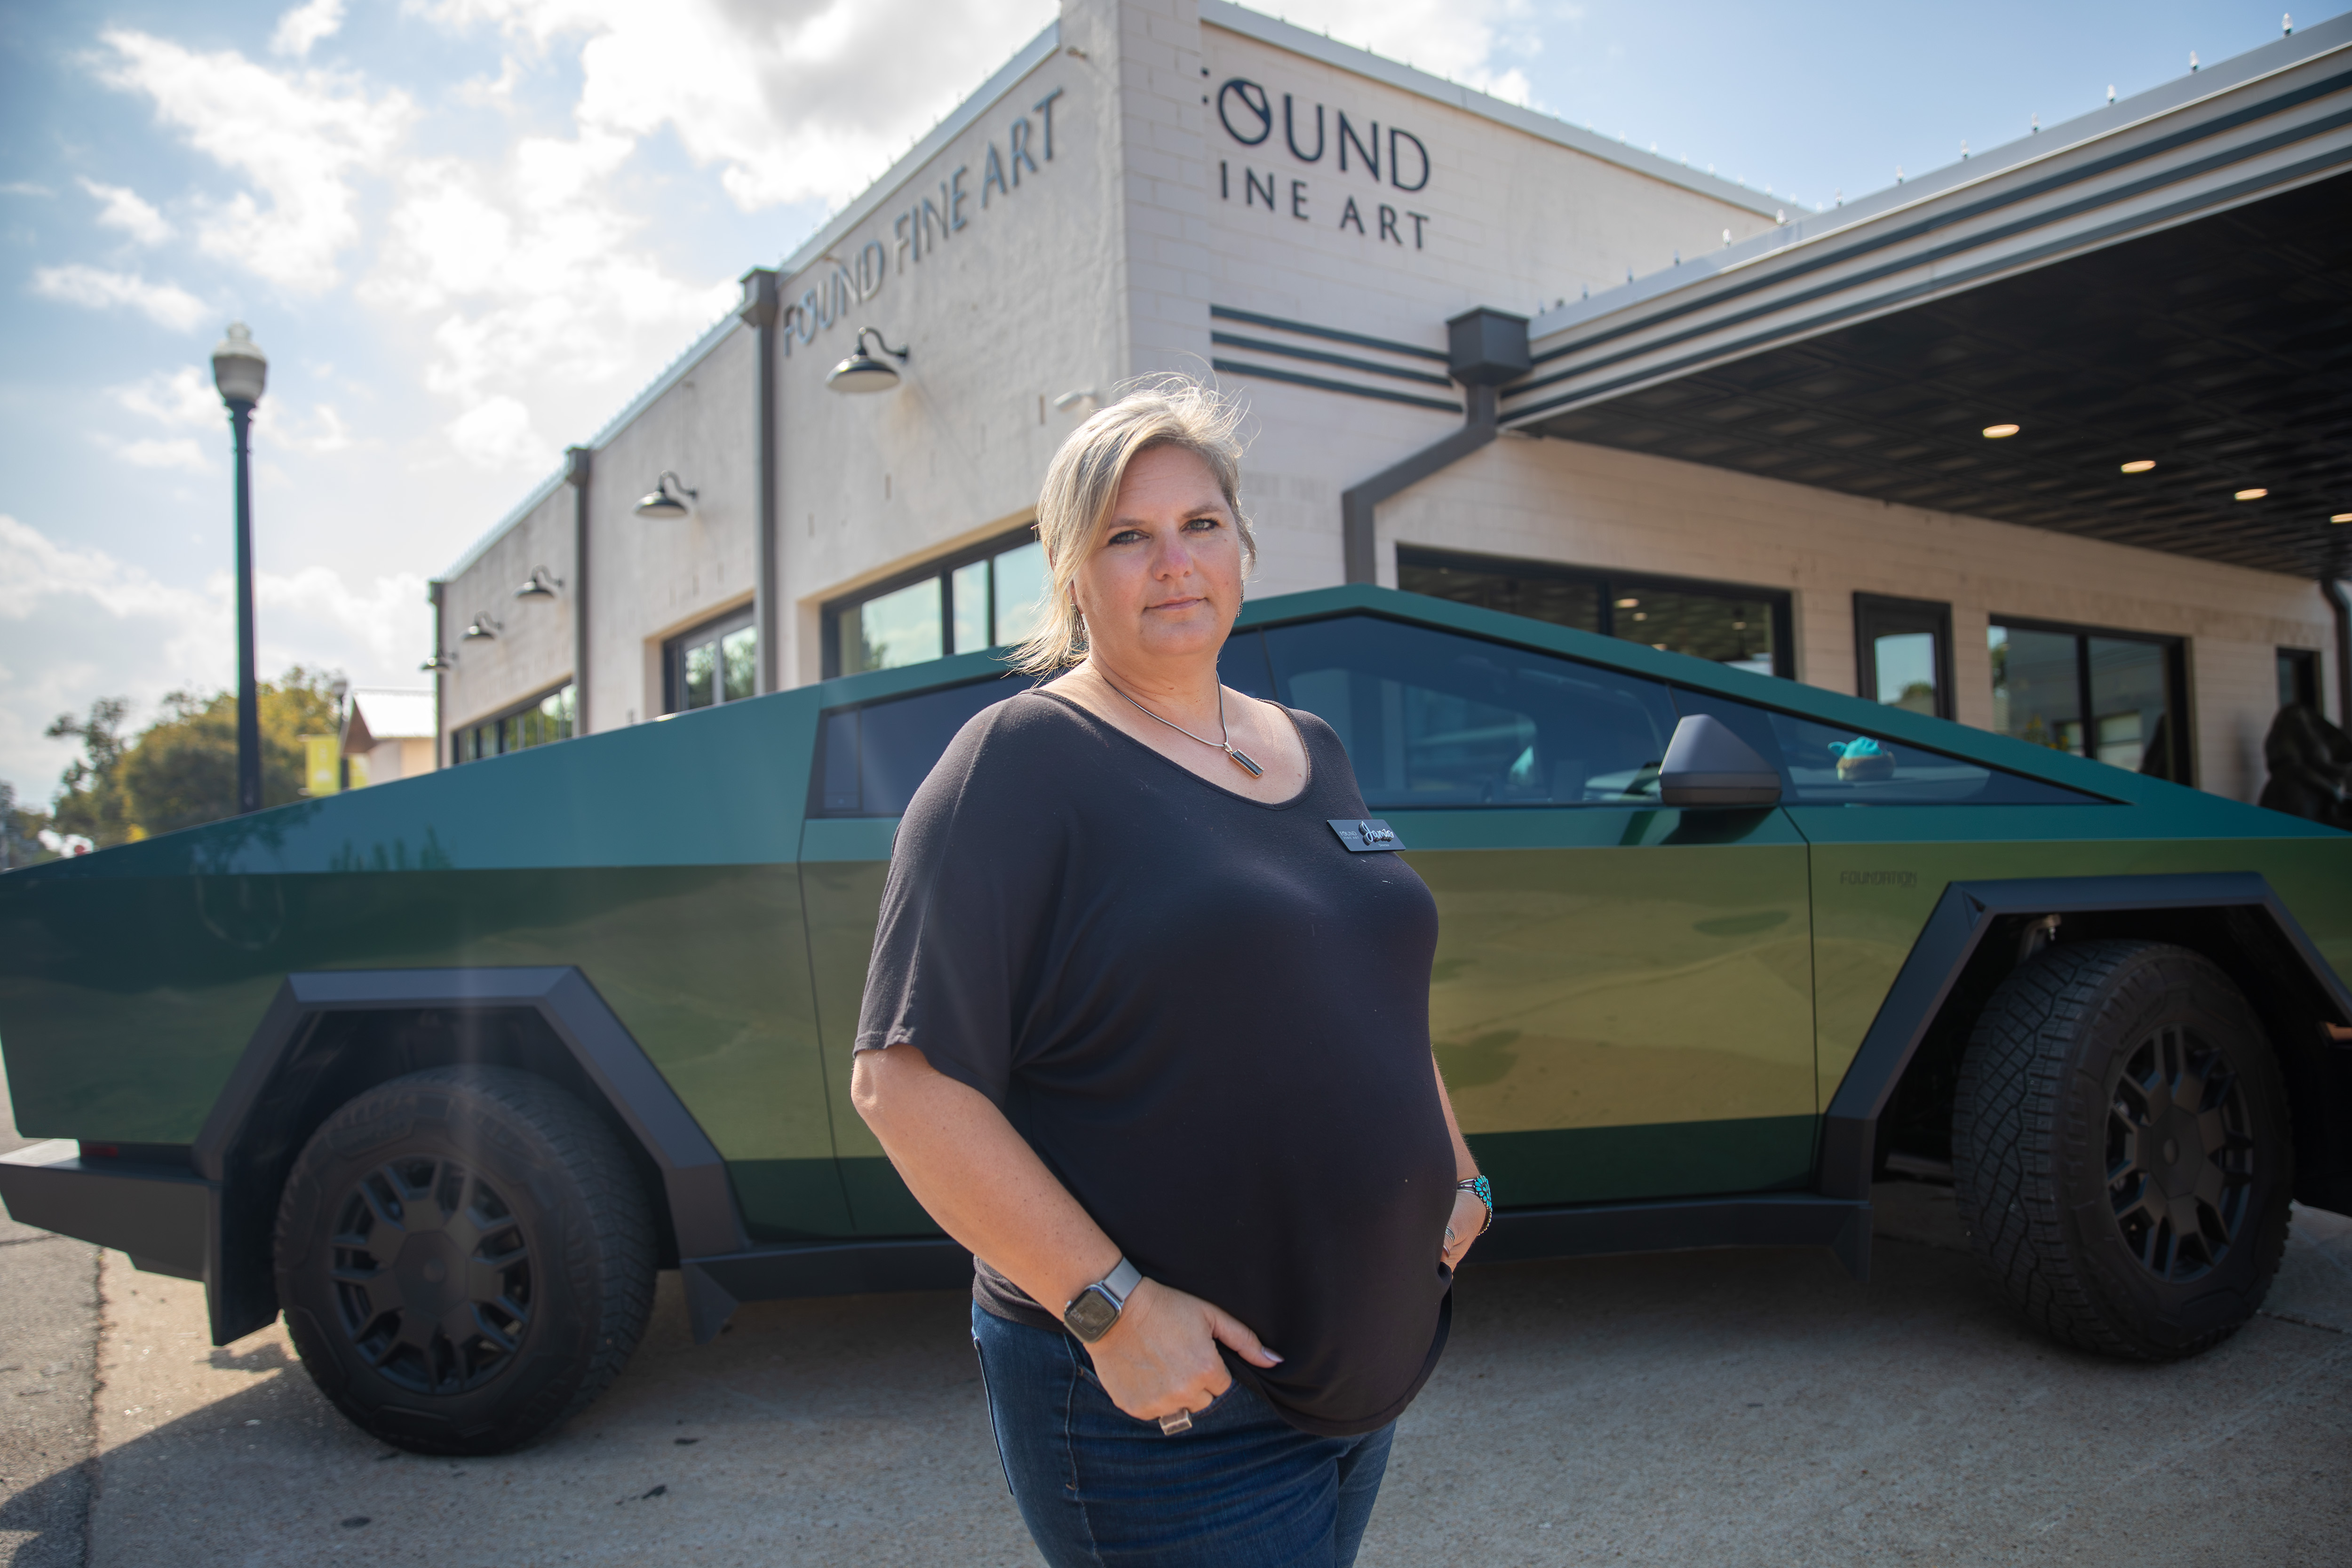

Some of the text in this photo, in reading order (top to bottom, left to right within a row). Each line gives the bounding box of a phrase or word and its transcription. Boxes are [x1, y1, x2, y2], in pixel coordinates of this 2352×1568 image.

[1201, 67, 1430, 192] OUND
[782, 85, 1064, 357] FOUND FINE ART
[1339, 194, 1430, 250] ART
[1840, 871, 1918, 885] FOUNDATION
